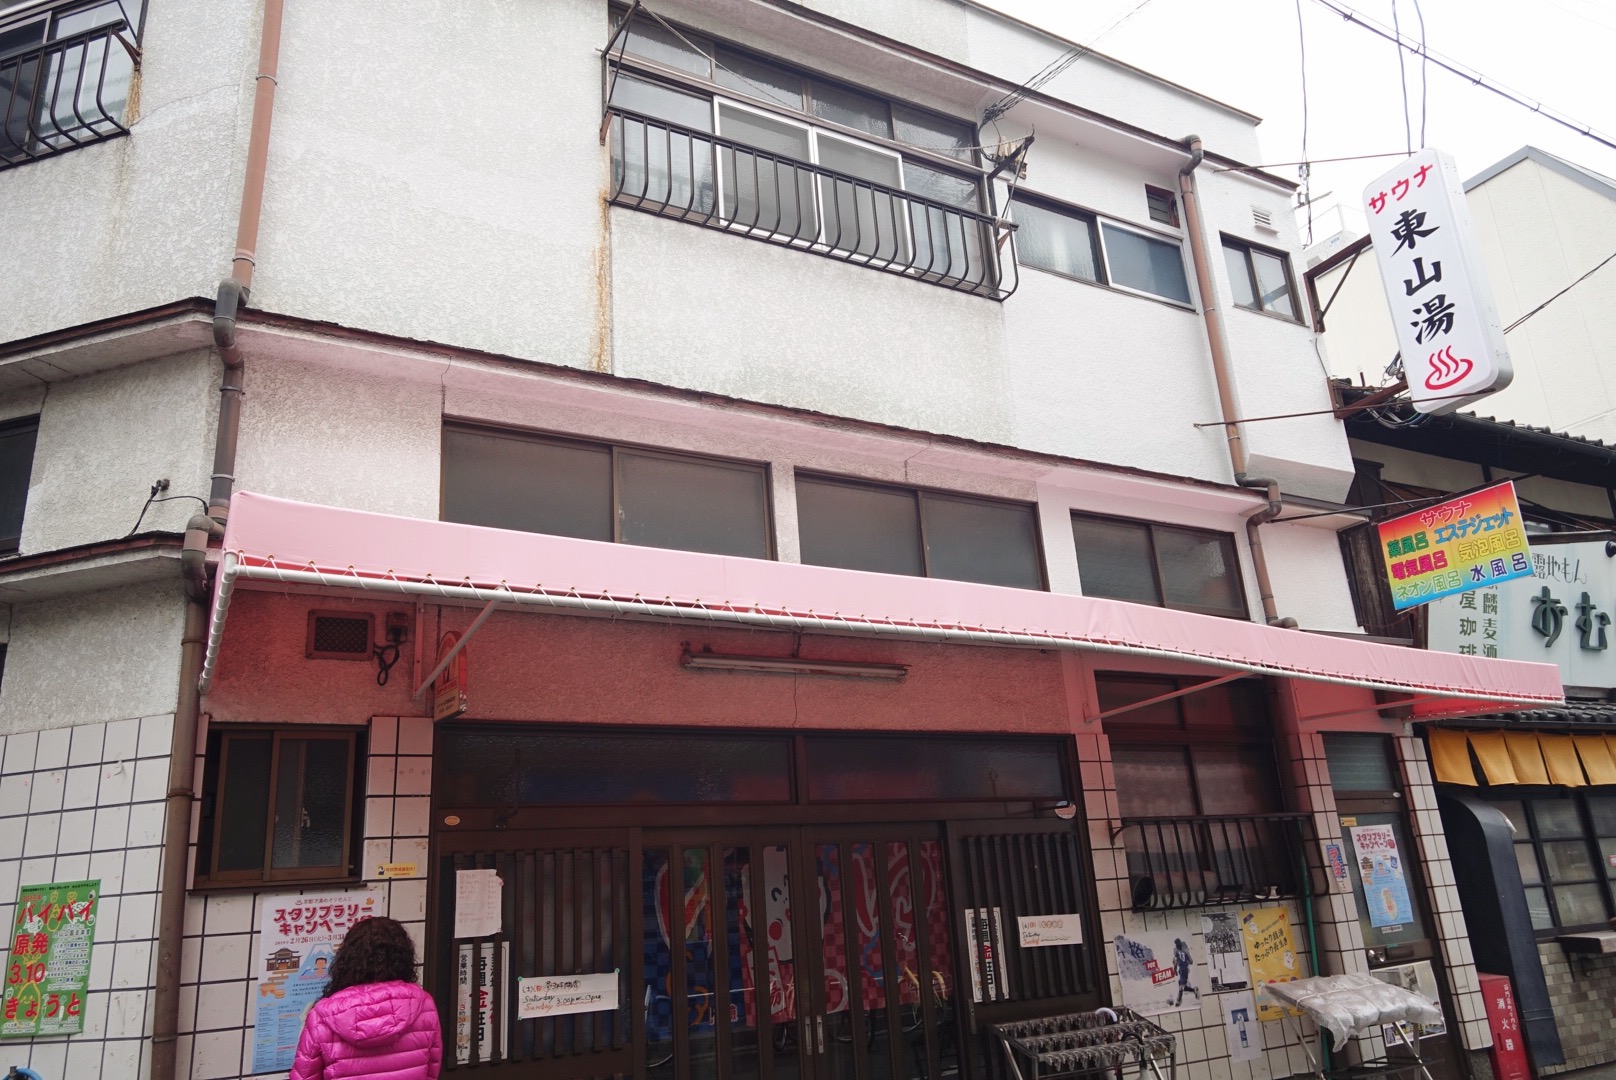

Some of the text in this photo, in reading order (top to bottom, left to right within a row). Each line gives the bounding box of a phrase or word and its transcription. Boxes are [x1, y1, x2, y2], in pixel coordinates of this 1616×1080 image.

[1368, 163, 1434, 215] サウナ
[1390, 208, 1456, 346] 東山湯
[1420, 501, 1471, 529] サウナ
[1434, 506, 1514, 545] エステジェット
[1387, 531, 1430, 559] 薬風呂
[1459, 528, 1522, 562] 気泡風呂
[1391, 549, 1448, 580] 電気風呂
[1397, 570, 1463, 601] ネオン風呂
[17, 899, 95, 926] バイバイ
[273, 903, 374, 923] スタンプラリー
[12, 932, 49, 956] 原発
[8, 962, 46, 985] 3.10
[1154, 969, 1172, 982] TEAM
[4, 992, 82, 1019] きょうと
[522, 993, 556, 1004] Saturday
[523, 1002, 554, 1013] Sunday
[1496, 998, 1515, 1051] 消火器
